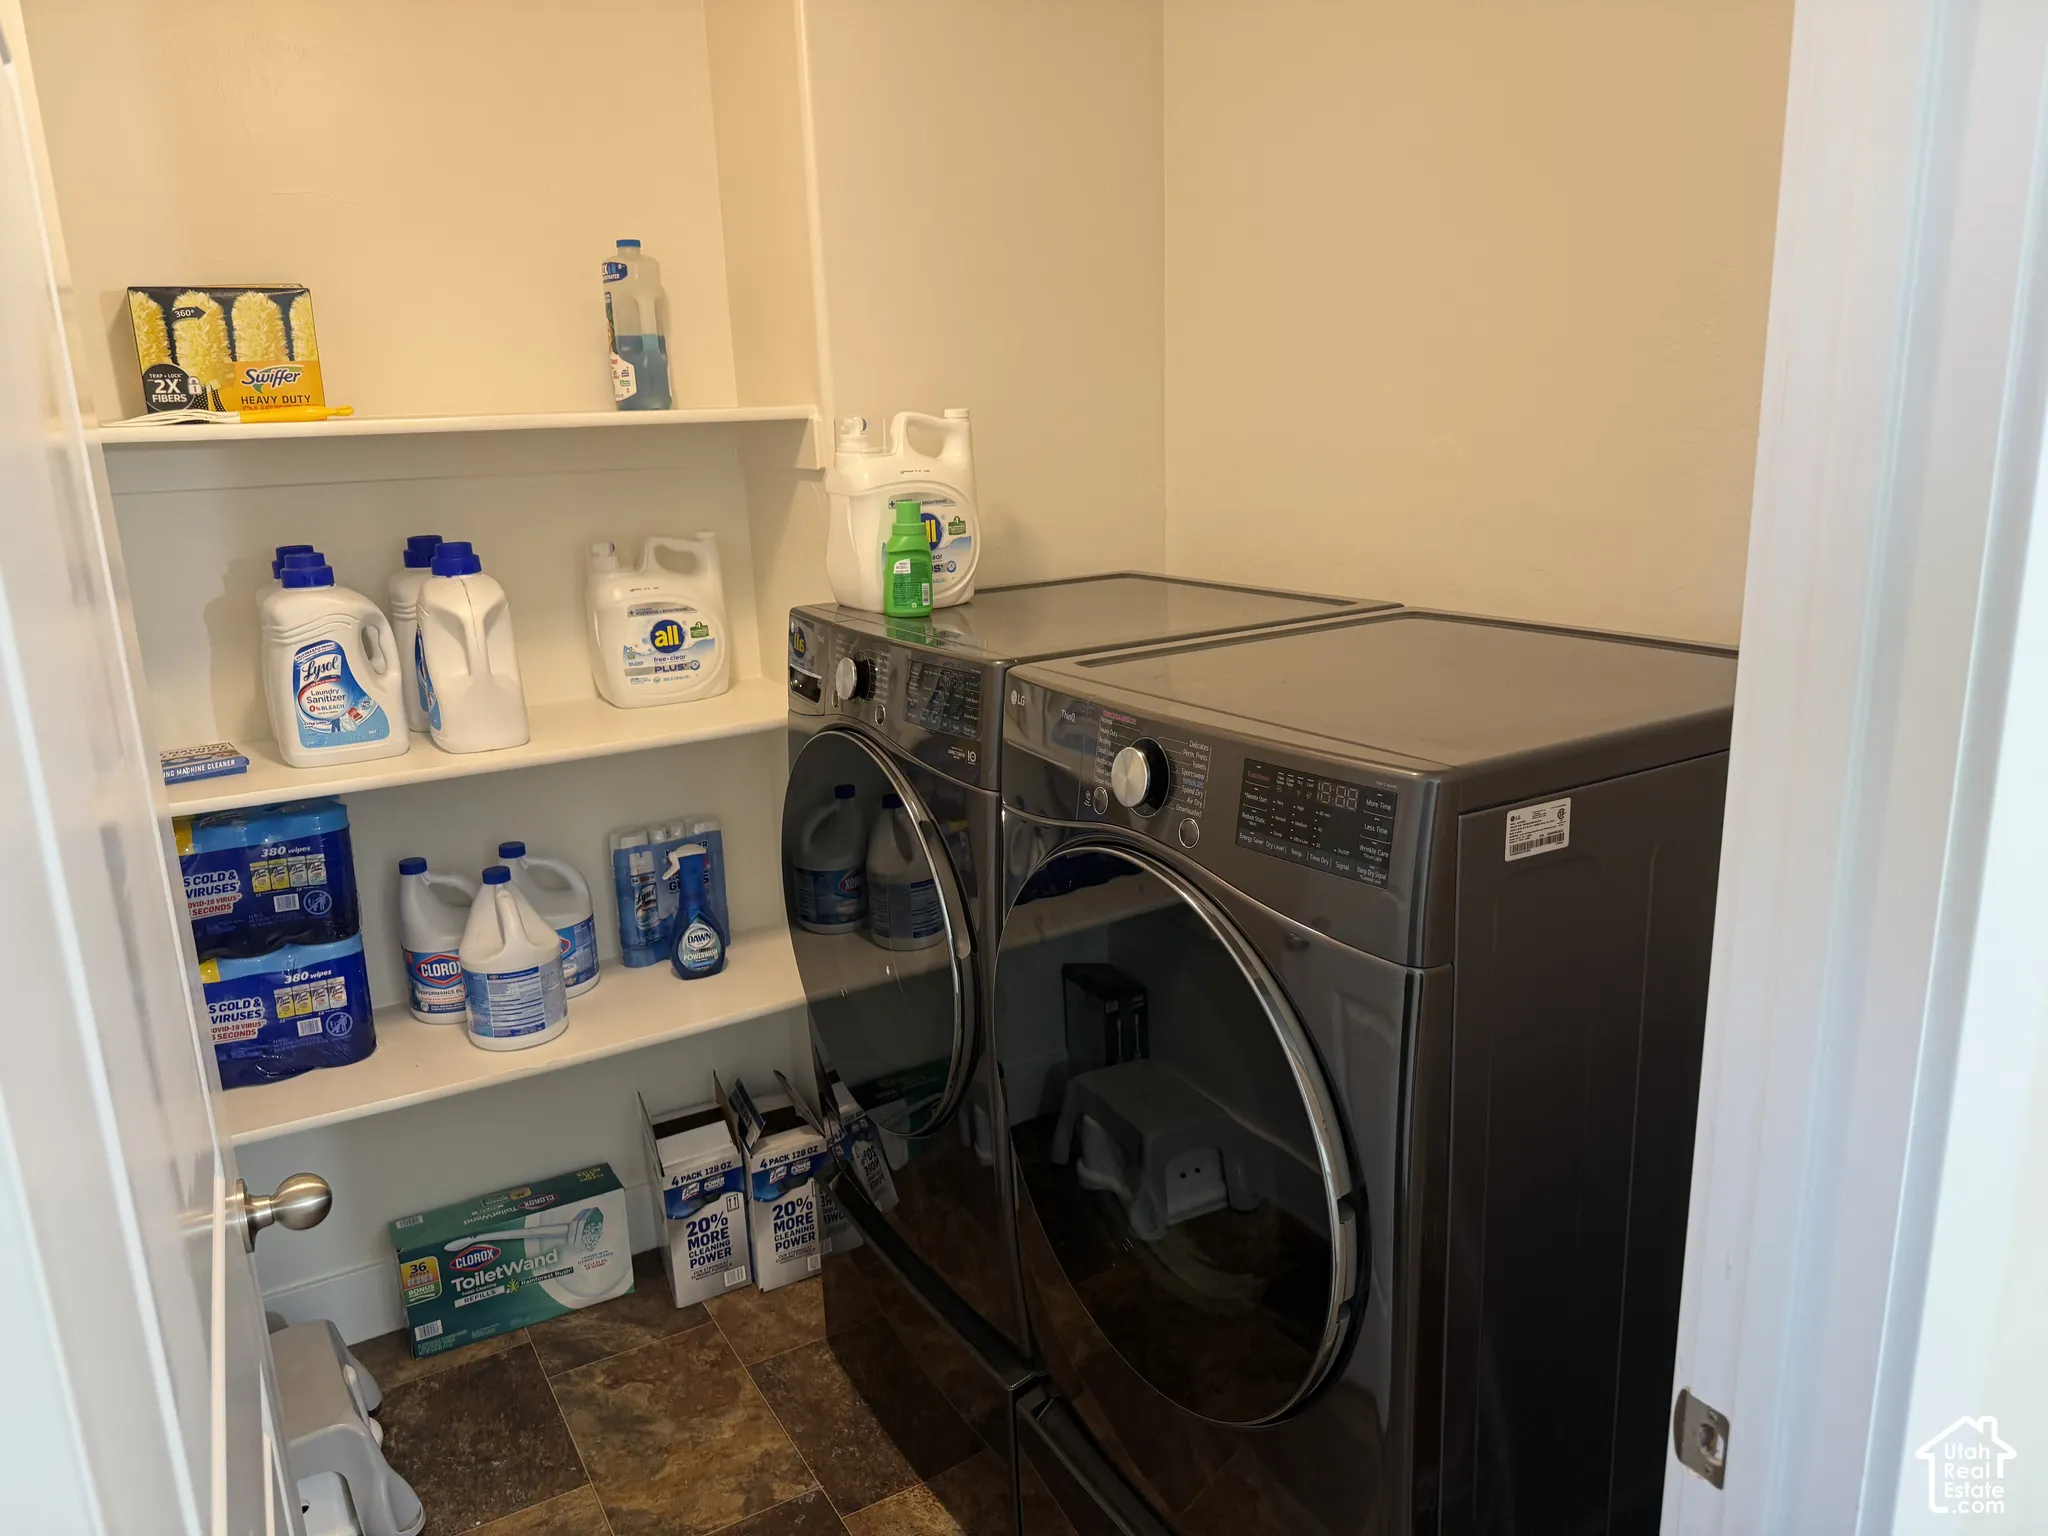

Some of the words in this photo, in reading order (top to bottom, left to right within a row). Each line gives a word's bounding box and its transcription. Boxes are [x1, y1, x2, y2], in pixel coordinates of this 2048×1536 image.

[241, 368, 301, 389] Swiffer
[155, 379, 179, 394] 2X
[152, 394, 188, 403] FIBERS
[241, 395, 278, 405] HEAVY
[282, 395, 312, 404] DUTY
[925, 520, 937, 543] ll
[655, 625, 680, 647] all
[301, 655, 339, 682] Lysol
[654, 663, 685, 673] PLUS
[310, 688, 340, 696] Laundry
[306, 694, 346, 704] Sanitizer
[1017, 694, 1025, 706] LG
[1061, 709, 1076, 723] ThinQ
[1189, 740, 1209, 752] Delicates
[1196, 752, 1208, 761] Press
[163, 770, 175, 778] ING
[176, 765, 206, 776] MACHINE
[207, 759, 235, 770] CLEANER
[1193, 760, 1206, 770] Towels
[1181, 768, 1205, 780] Sportswear
[1195, 789, 1203, 798] Dry
[1194, 799, 1202, 808] Dry
[1366, 799, 1379, 808] More
[1380, 802, 1392, 811] Time
[1175, 804, 1202, 818] Downloaded
[1364, 823, 1375, 832] Less
[1376, 826, 1388, 835] Time
[1239, 832, 1253, 843] Energy
[1253, 836, 1264, 845] Saver
[261, 846, 287, 857] 380
[288, 845, 311, 854] wipes
[1265, 840, 1273, 850] Dry
[1273, 843, 1285, 852] Level
[1360, 845, 1377, 855] Wrinkle
[1377, 849, 1389, 858] Care
[1310, 854, 1320, 863] Time
[1320, 857, 1329, 866] Dry
[1336, 862, 1350, 871] Signal
[195, 873, 225, 886] COLD
[228, 871, 237, 880] &
[1375, 871, 1387, 880] Signal
[185, 882, 238, 898] VIRUSES
[187, 898, 215, 909] OVID-19
[215, 896, 237, 904] VIRUS
[192, 904, 232, 915] SECONDS
[687, 933, 712, 943] DAWN
[683, 948, 718, 961] POWERWASH
[284, 971, 309, 984] 380
[310, 969, 332, 979] wipes
[221, 1000, 251, 1013] COLD
[253, 999, 262, 1008] &
[211, 1009, 262, 1025] VIRUSES
[241, 1021, 262, 1030] VIRUS
[217, 1029, 257, 1041] SECONDS
[760, 1158, 767, 1169] 4
[769, 1154, 790, 1166] PACK
[792, 1149, 806, 1159] 128
[808, 1145, 818, 1154] OZ
[671, 1175, 680, 1186] 4
[681, 1170, 702, 1183] PACK
[705, 1165, 719, 1176] 128
[720, 1161, 732, 1170] OZ
[523, 1194, 555, 1208] CLOROX
[773, 1195, 813, 1221] 20%
[464, 1206, 519, 1226] ToiletWand
[773, 1211, 814, 1234] MORE
[685, 1210, 728, 1237] 20%
[687, 1226, 730, 1251] MORE
[774, 1223, 815, 1242] CLEANING
[775, 1231, 816, 1253] POWER
[689, 1239, 731, 1259] CLEANING
[455, 1249, 495, 1269] CLOROX
[690, 1246, 732, 1269] POWER
[410, 1262, 427, 1275] 36
[451, 1248, 559, 1293] ToiletWand
[521, 1274, 554, 1286] Rainforest
[408, 1284, 435, 1296] BONUS
[475, 1283, 497, 1292] Cleaning
[464, 1289, 497, 1304] REFILLS
